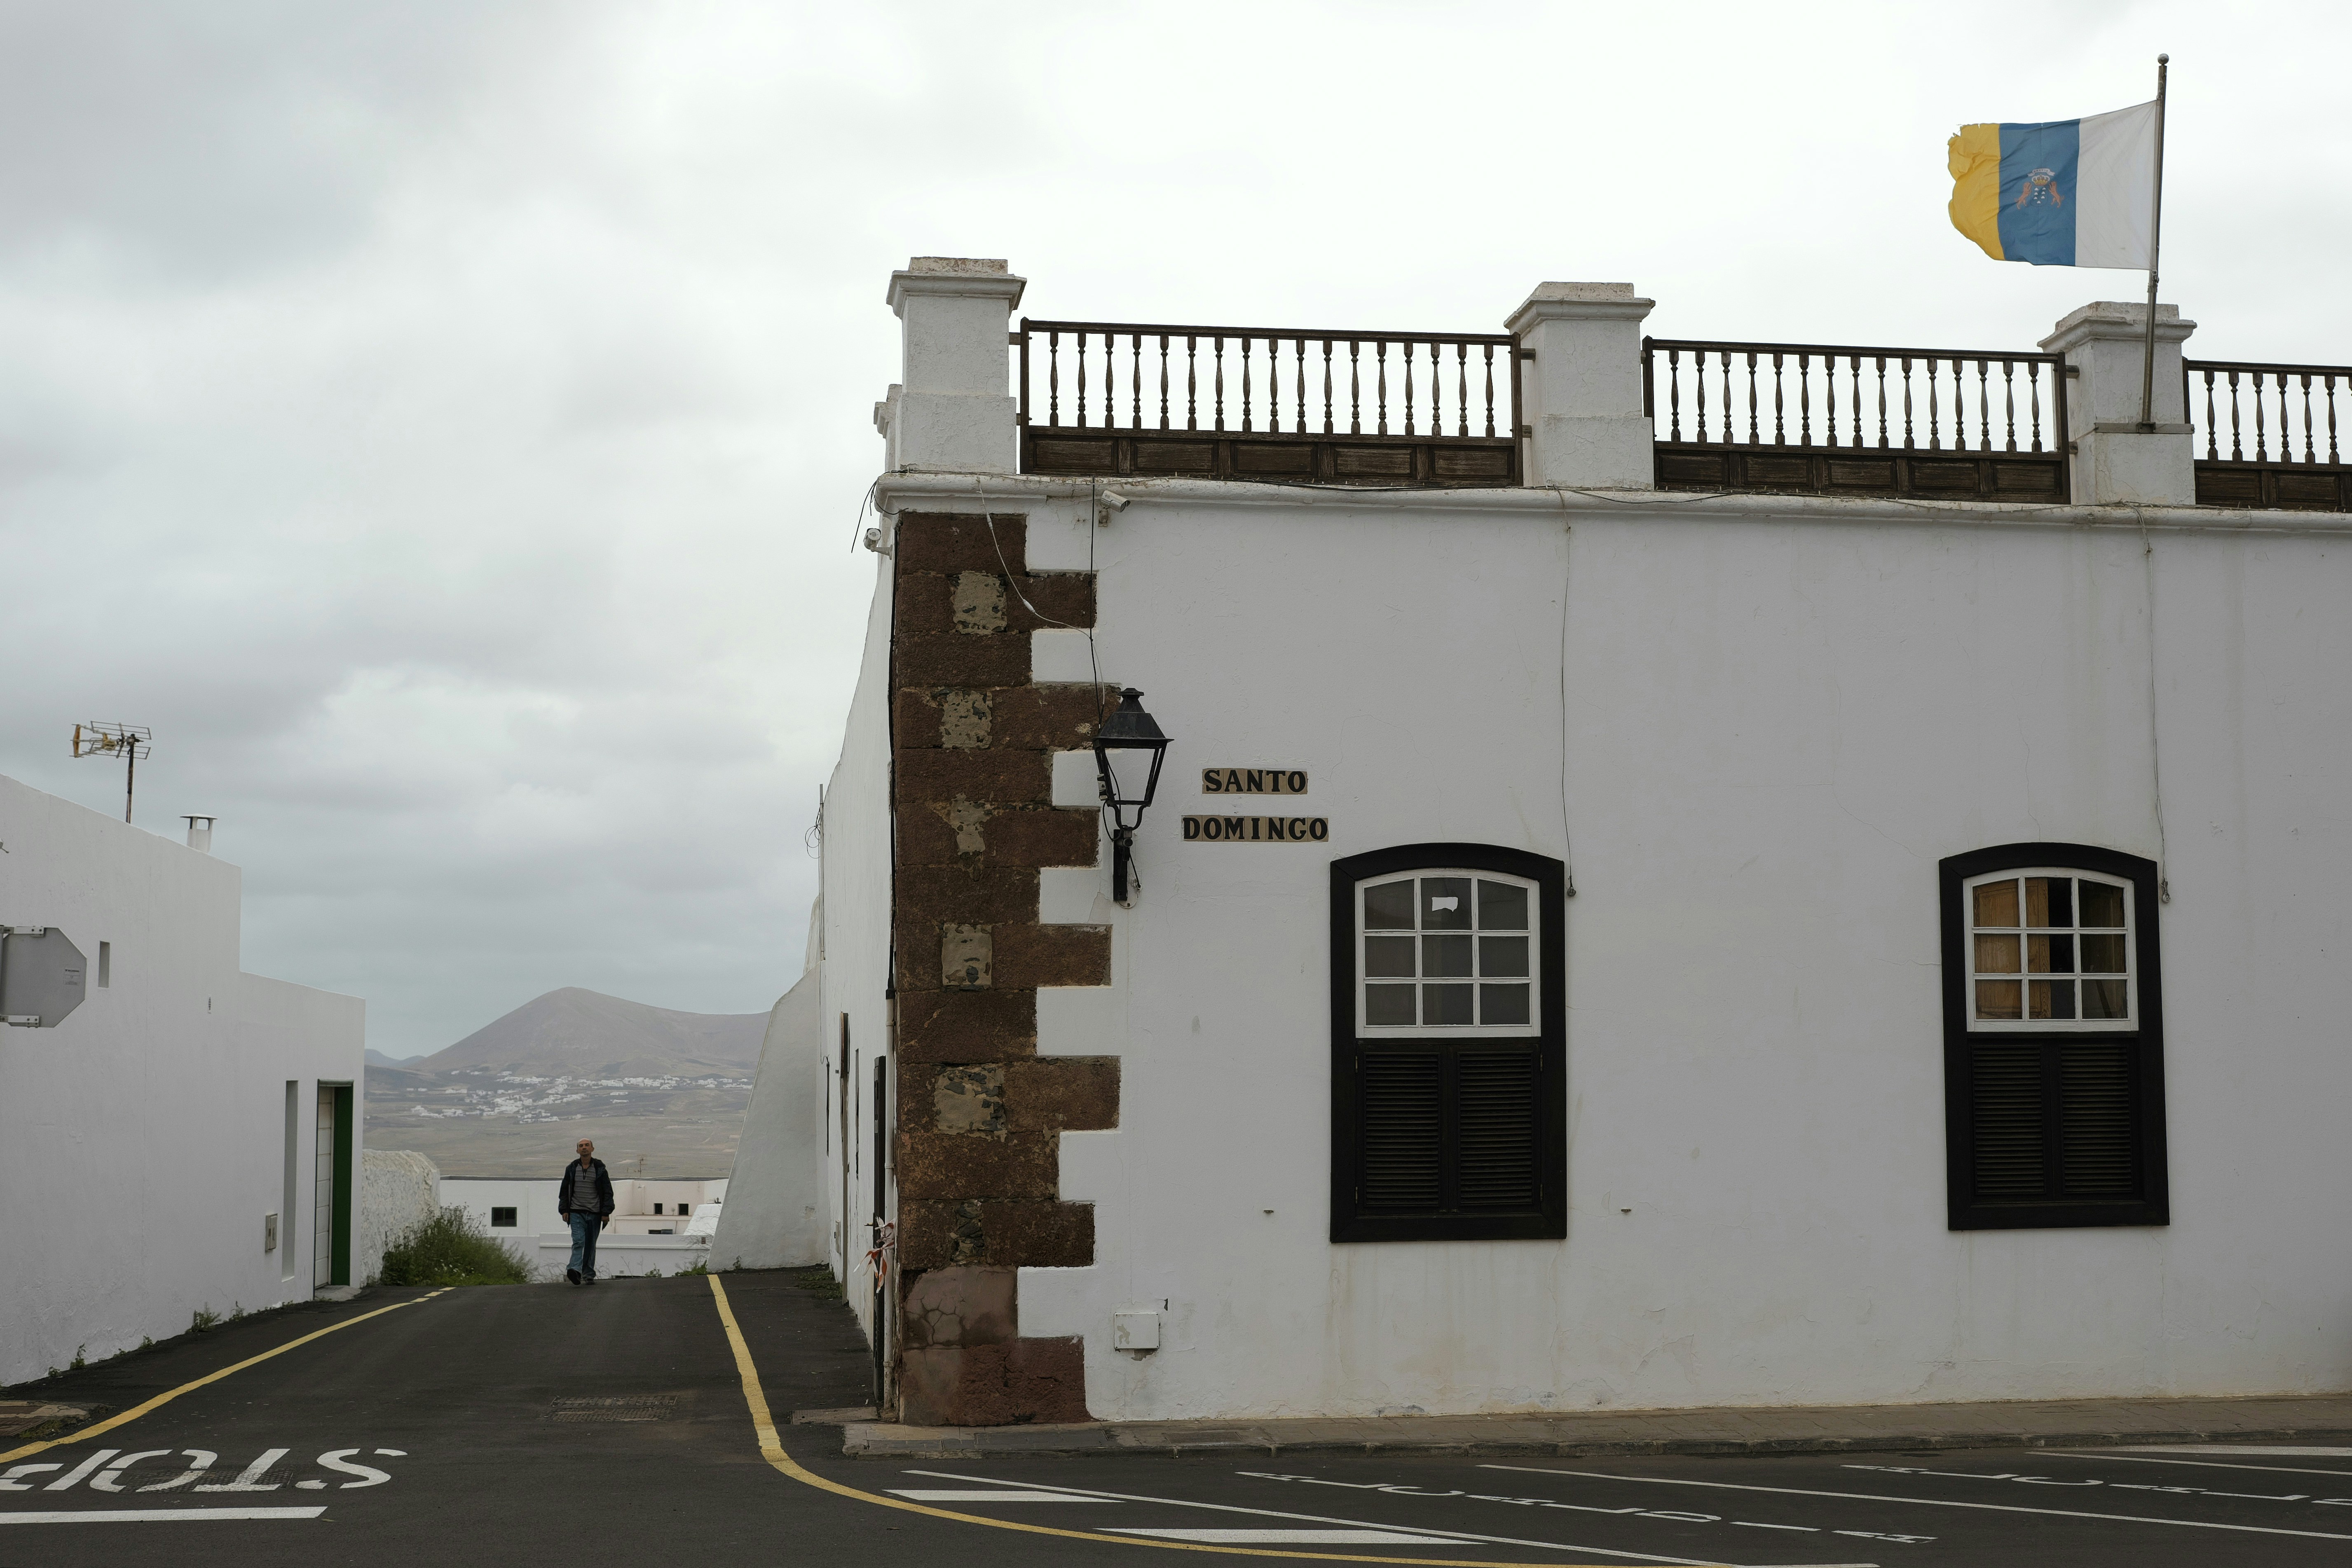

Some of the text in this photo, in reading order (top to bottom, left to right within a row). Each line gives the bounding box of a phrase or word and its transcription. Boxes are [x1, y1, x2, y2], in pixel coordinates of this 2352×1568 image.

[1204, 769, 1306, 793] SANTO
[1183, 817, 1328, 840] DOMINGO
[0, 1448, 408, 1492] STOP
